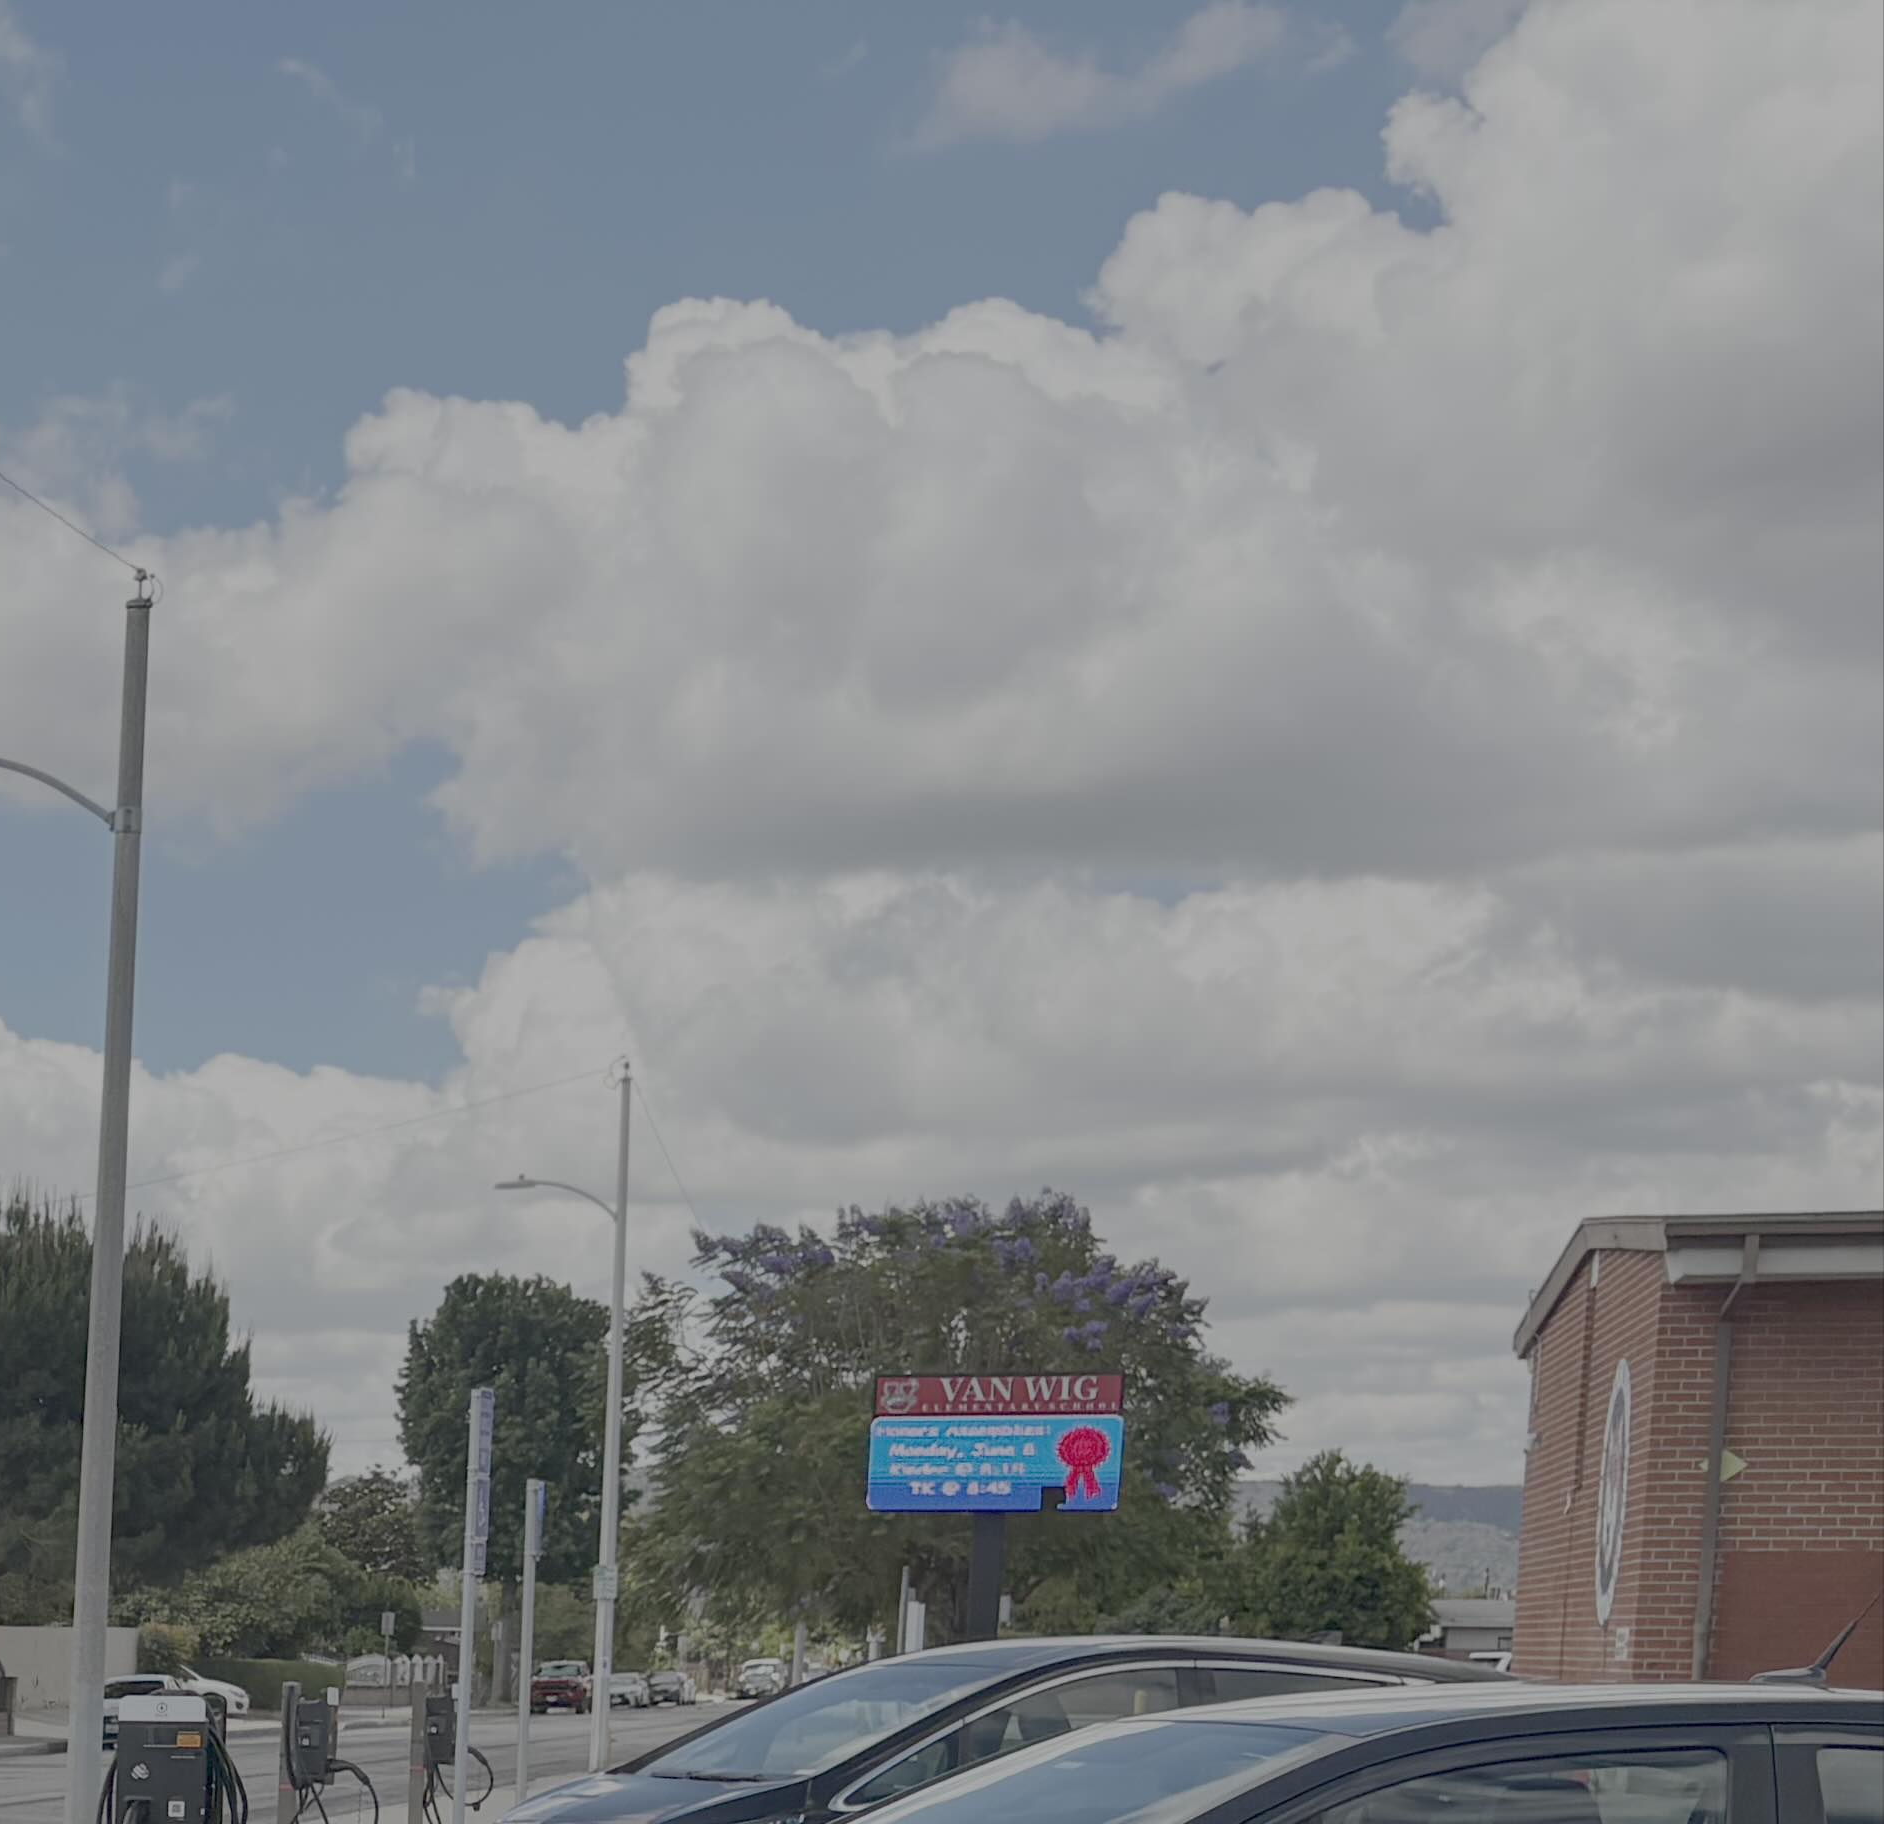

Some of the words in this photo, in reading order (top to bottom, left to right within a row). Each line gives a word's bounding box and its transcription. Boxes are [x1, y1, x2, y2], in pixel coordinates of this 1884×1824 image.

[939, 1376, 1015, 1401] VAN
[1024, 1376, 1098, 1401] WIG
[922, 1403, 1047, 1412] ELEMENTARY
[1049, 1402, 1119, 1411] SCHOOL
[889, 1442, 964, 1460] Monday,
[971, 1443, 1015, 1456] June
[909, 1481, 936, 1495] TK
